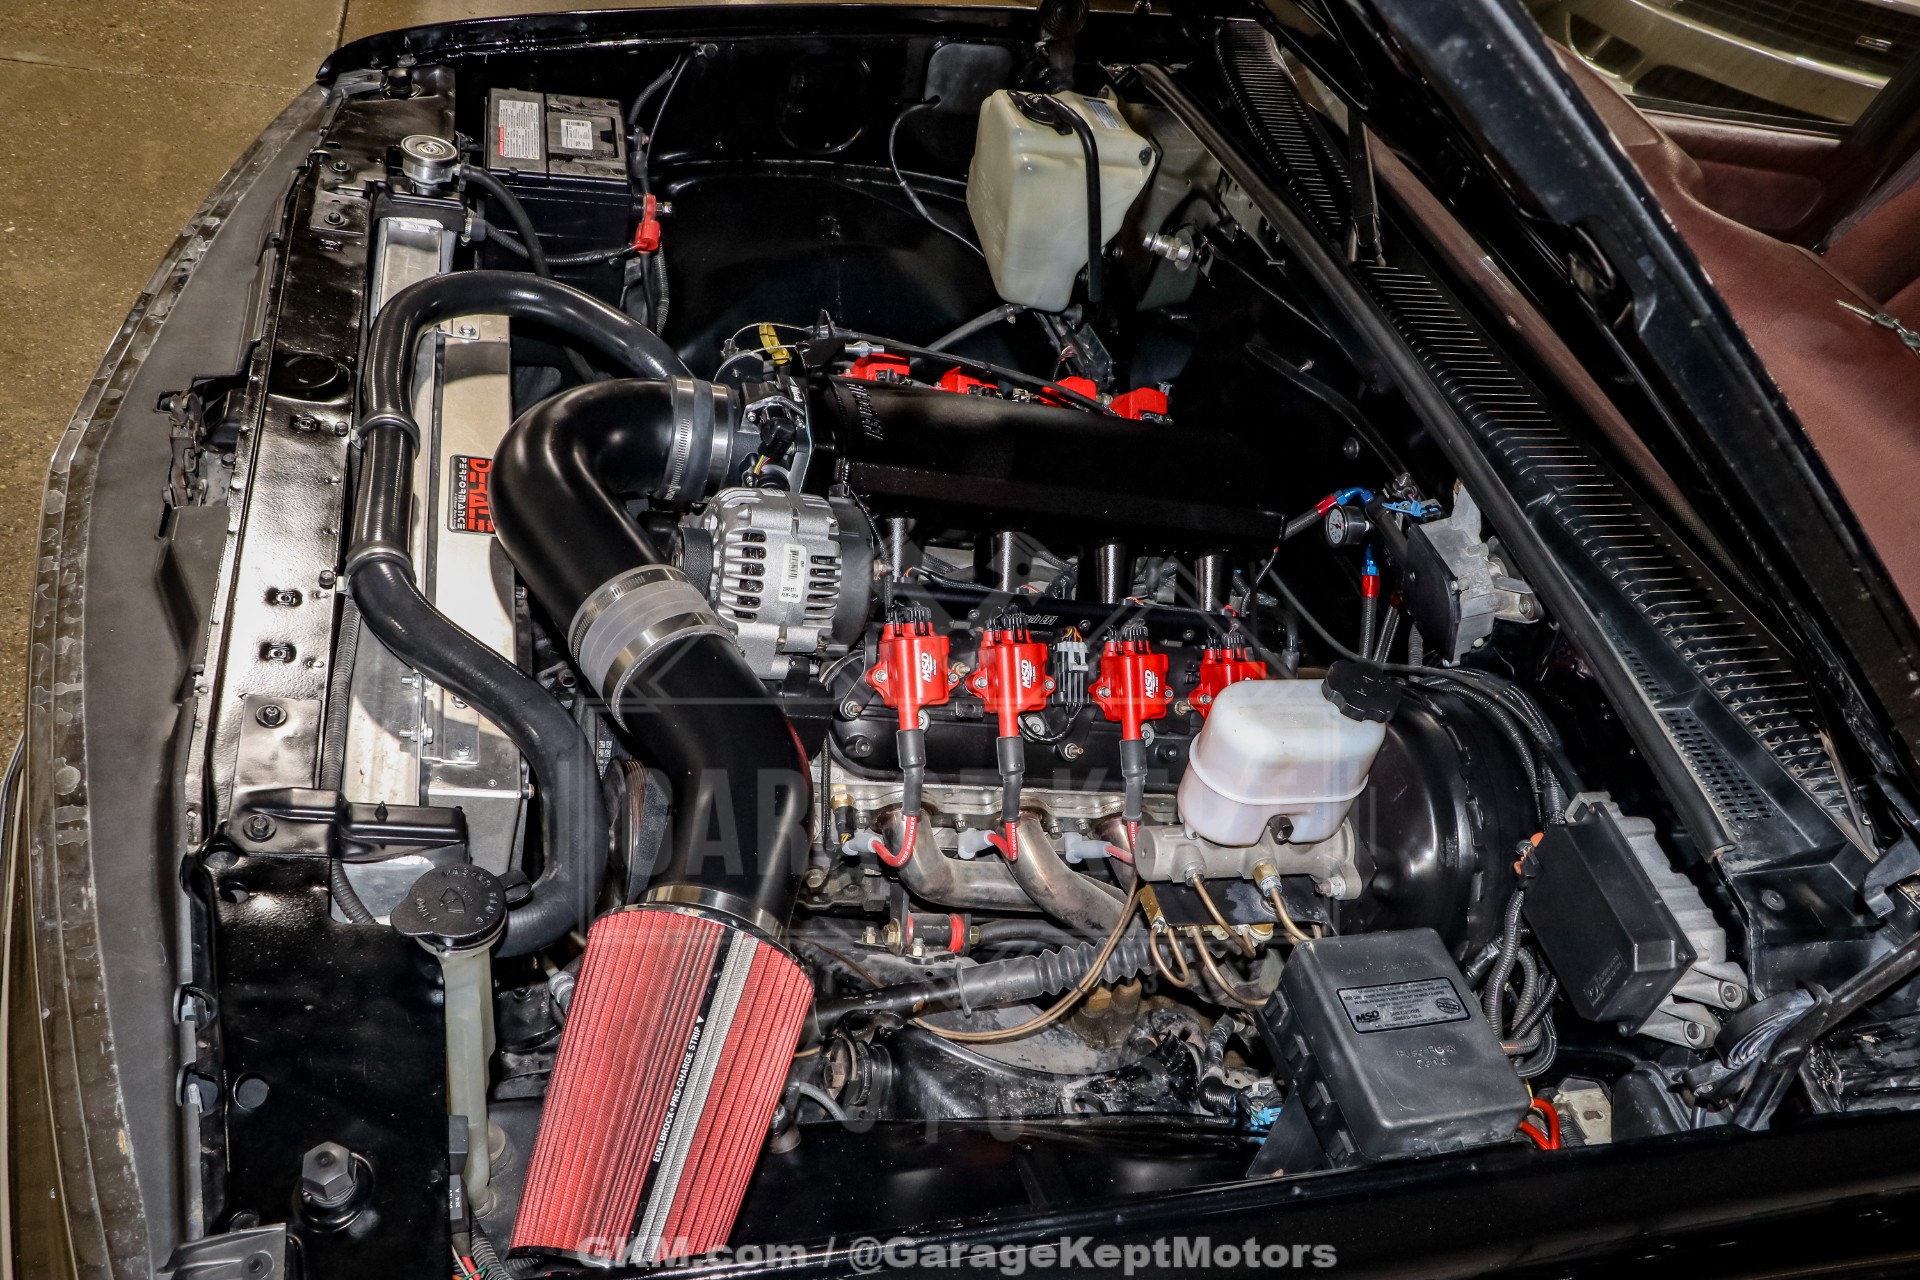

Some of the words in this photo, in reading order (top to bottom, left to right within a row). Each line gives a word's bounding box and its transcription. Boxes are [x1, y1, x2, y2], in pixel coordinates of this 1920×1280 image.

[457, 457, 467, 529] PERFORMANCE
[921, 653, 932, 682] MSD
[1021, 660, 1032, 689] MSD
[1145, 670, 1154, 698] MSD
[1356, 1010, 1380, 1023] MSD
[652, 1112, 675, 1163] EDELBROCK
[670, 1052, 694, 1109] PRO-CHARGE
[688, 1026, 701, 1051] STRIP
